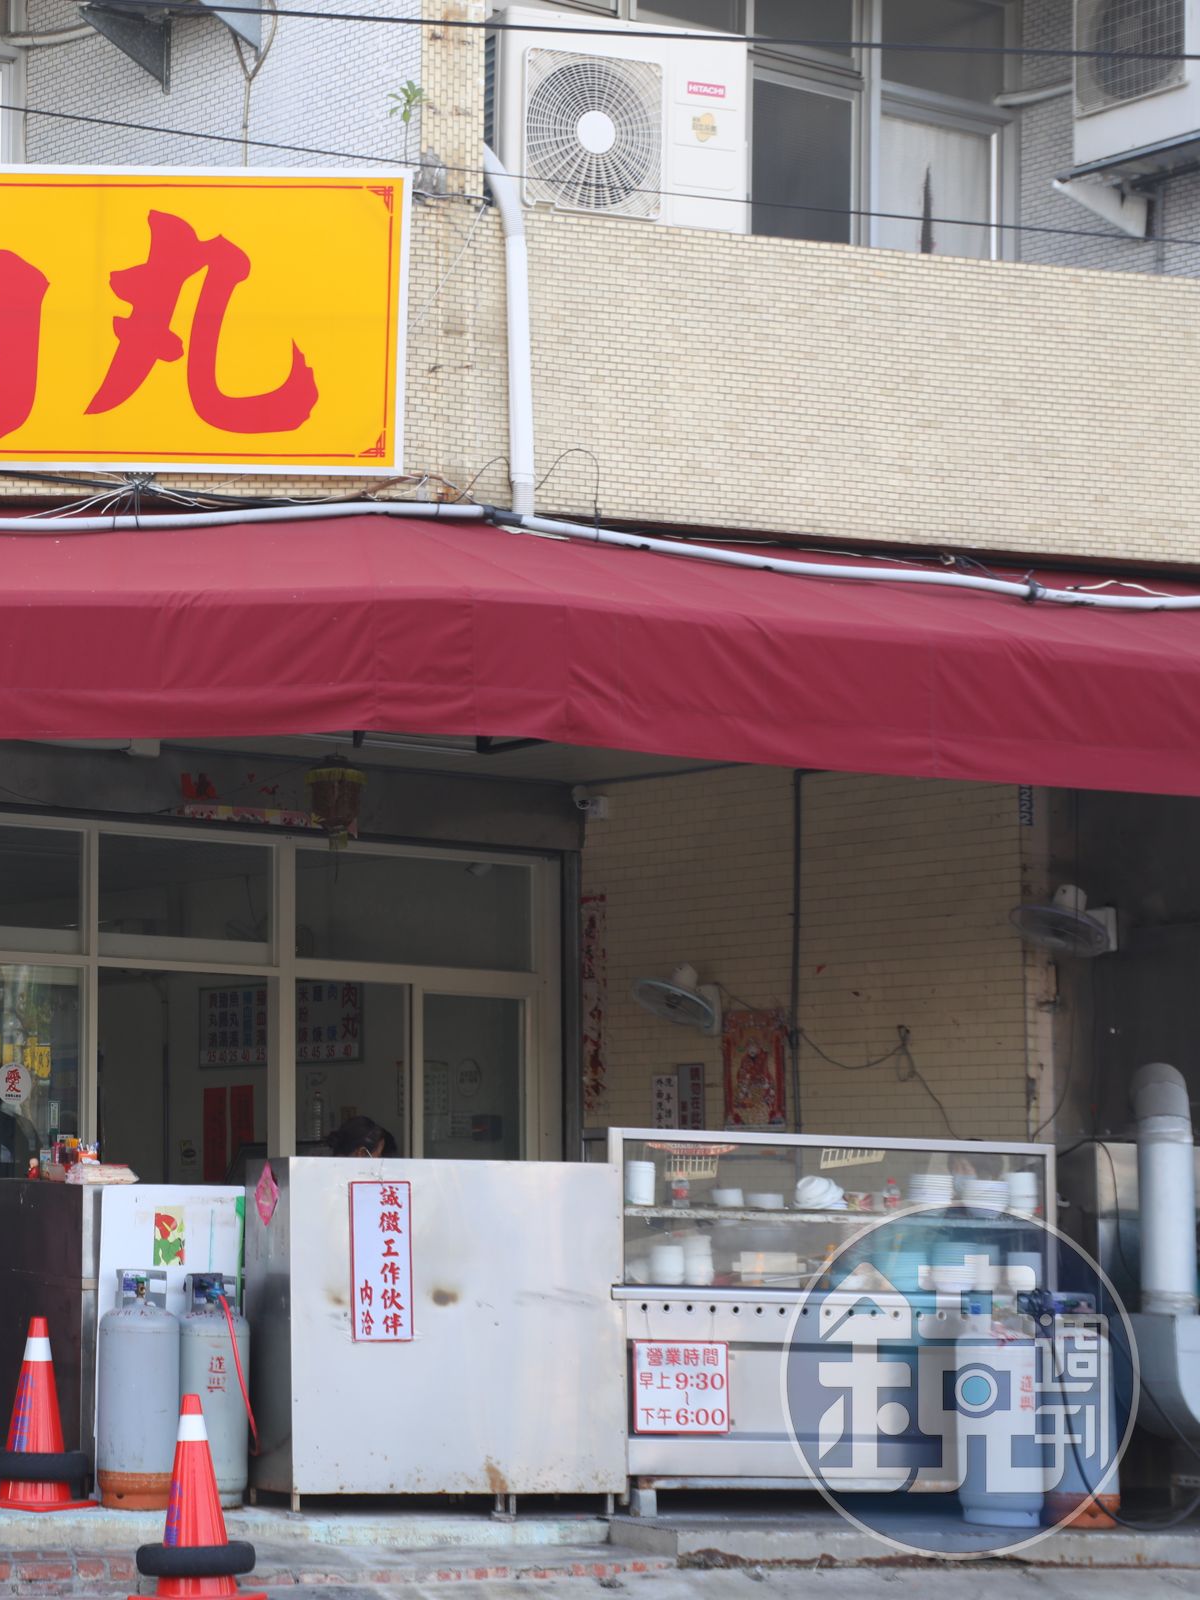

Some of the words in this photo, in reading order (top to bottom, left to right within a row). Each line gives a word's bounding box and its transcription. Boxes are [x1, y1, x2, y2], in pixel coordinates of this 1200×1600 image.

[689, 84, 724, 96] HITACHI
[5, 1069, 21, 1093] 愛
[379, 1185, 405, 1337] 誠徵工作伙伴
[360, 1279, 375, 1336] 內洽
[646, 1347, 719, 1367] 營業時間
[639, 1372, 725, 1391] 早上9:30
[640, 1408, 726, 1427] 下午6:00
